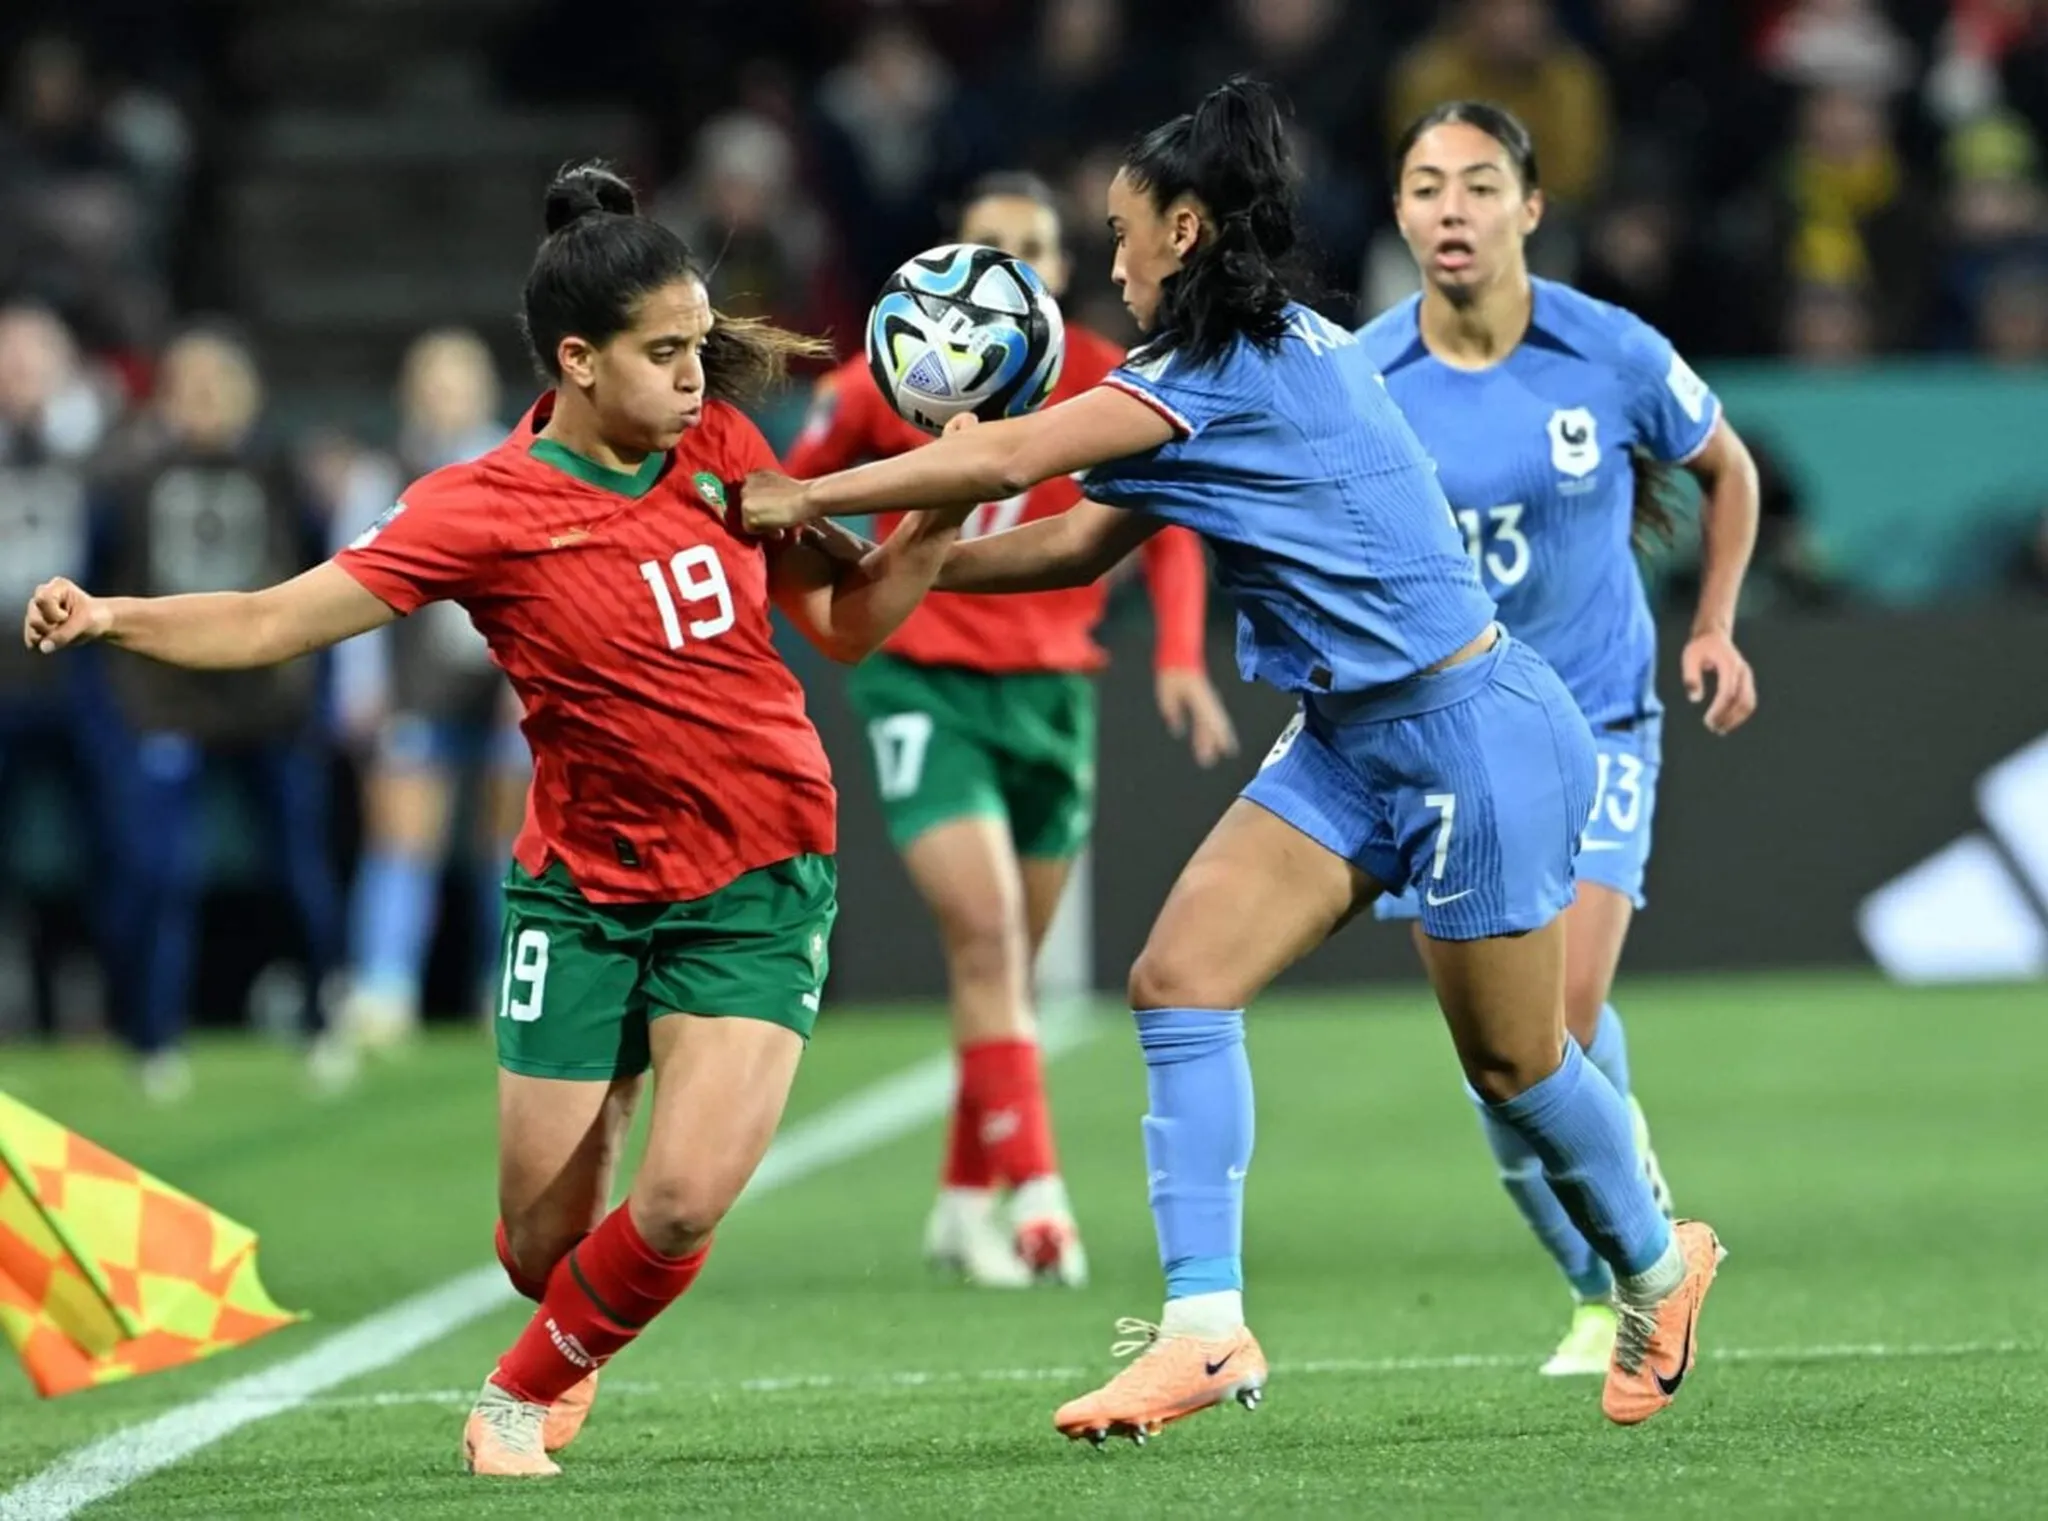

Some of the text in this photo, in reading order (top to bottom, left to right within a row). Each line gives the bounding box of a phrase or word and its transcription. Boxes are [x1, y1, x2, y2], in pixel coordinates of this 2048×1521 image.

[1458, 503, 1530, 585] 13
[640, 544, 735, 650] 19
[871, 711, 933, 801] 17
[1588, 753, 1643, 832] 13
[1424, 793, 1456, 879] 7
[499, 929, 550, 1022] 19
